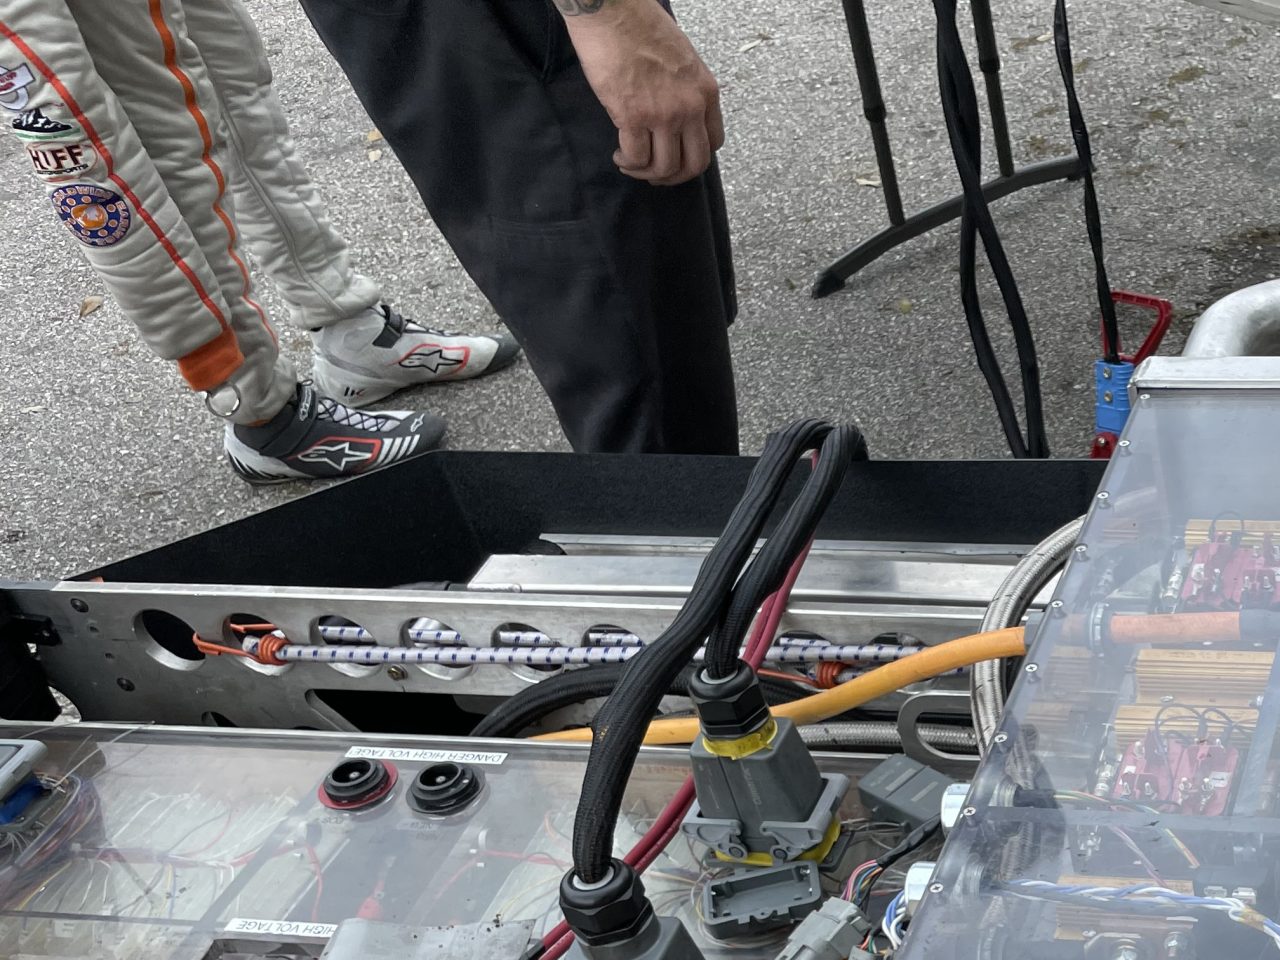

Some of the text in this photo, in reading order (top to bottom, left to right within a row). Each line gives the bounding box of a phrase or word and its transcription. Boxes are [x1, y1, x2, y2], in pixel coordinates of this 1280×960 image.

[413, 749, 447, 759] HIGH
[449, 751, 502, 763] DANGER
[236, 920, 336, 935] HIGH VOLTAGE
